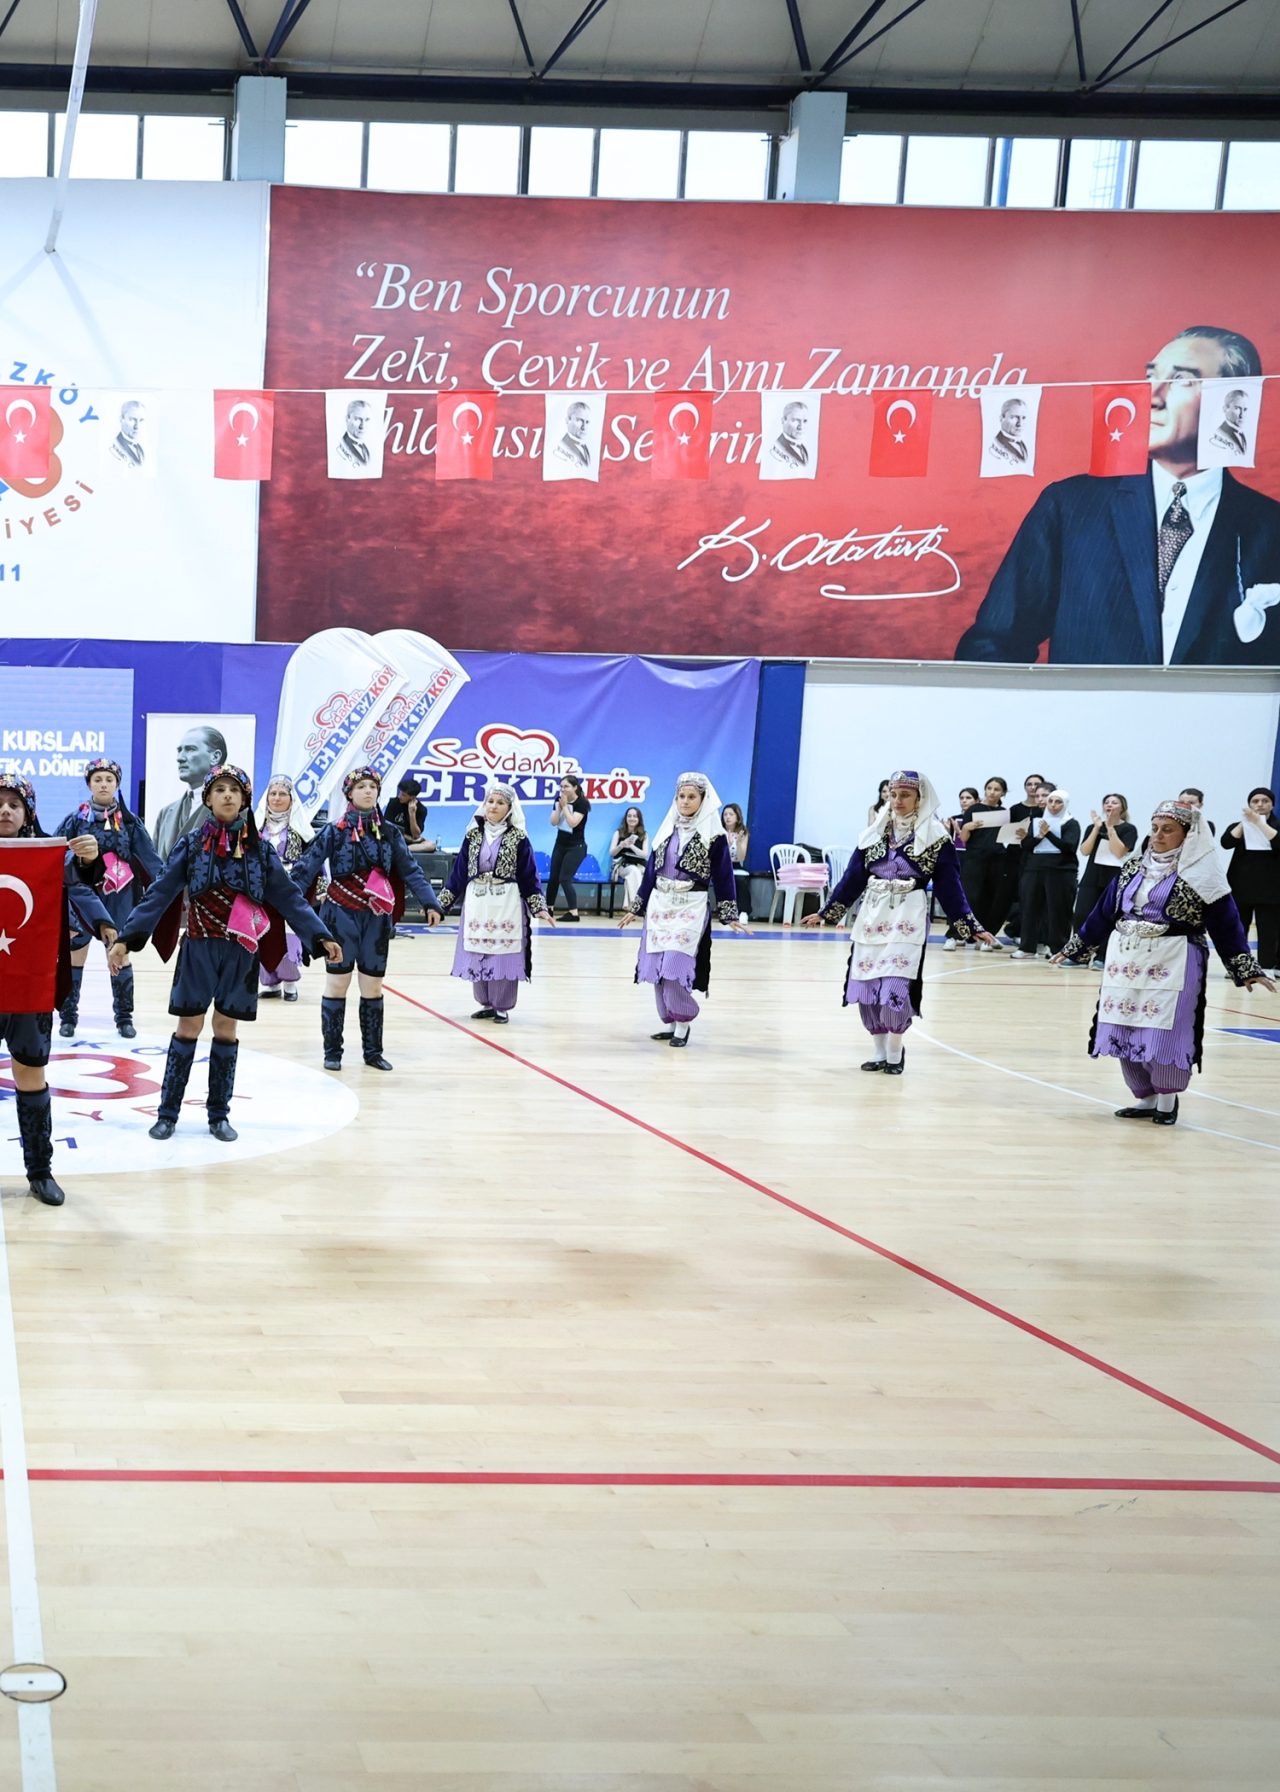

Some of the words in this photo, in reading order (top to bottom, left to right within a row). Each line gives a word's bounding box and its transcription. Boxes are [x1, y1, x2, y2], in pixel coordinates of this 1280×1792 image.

[477, 266, 731, 328] Sporcunun
[344, 333, 459, 388] Zeki,
[481, 339, 612, 396] Çevik
[623, 357, 670, 391] ve
[682, 345, 785, 405] Aynı
[798, 348, 1029, 399] Zamanda
[2, 730, 105, 753] KURSLARI
[294, 665, 396, 804] ÇERKEZKÖY
[370, 668, 454, 779] ERKEZKÖY
[424, 742, 578, 775] Sevdamız
